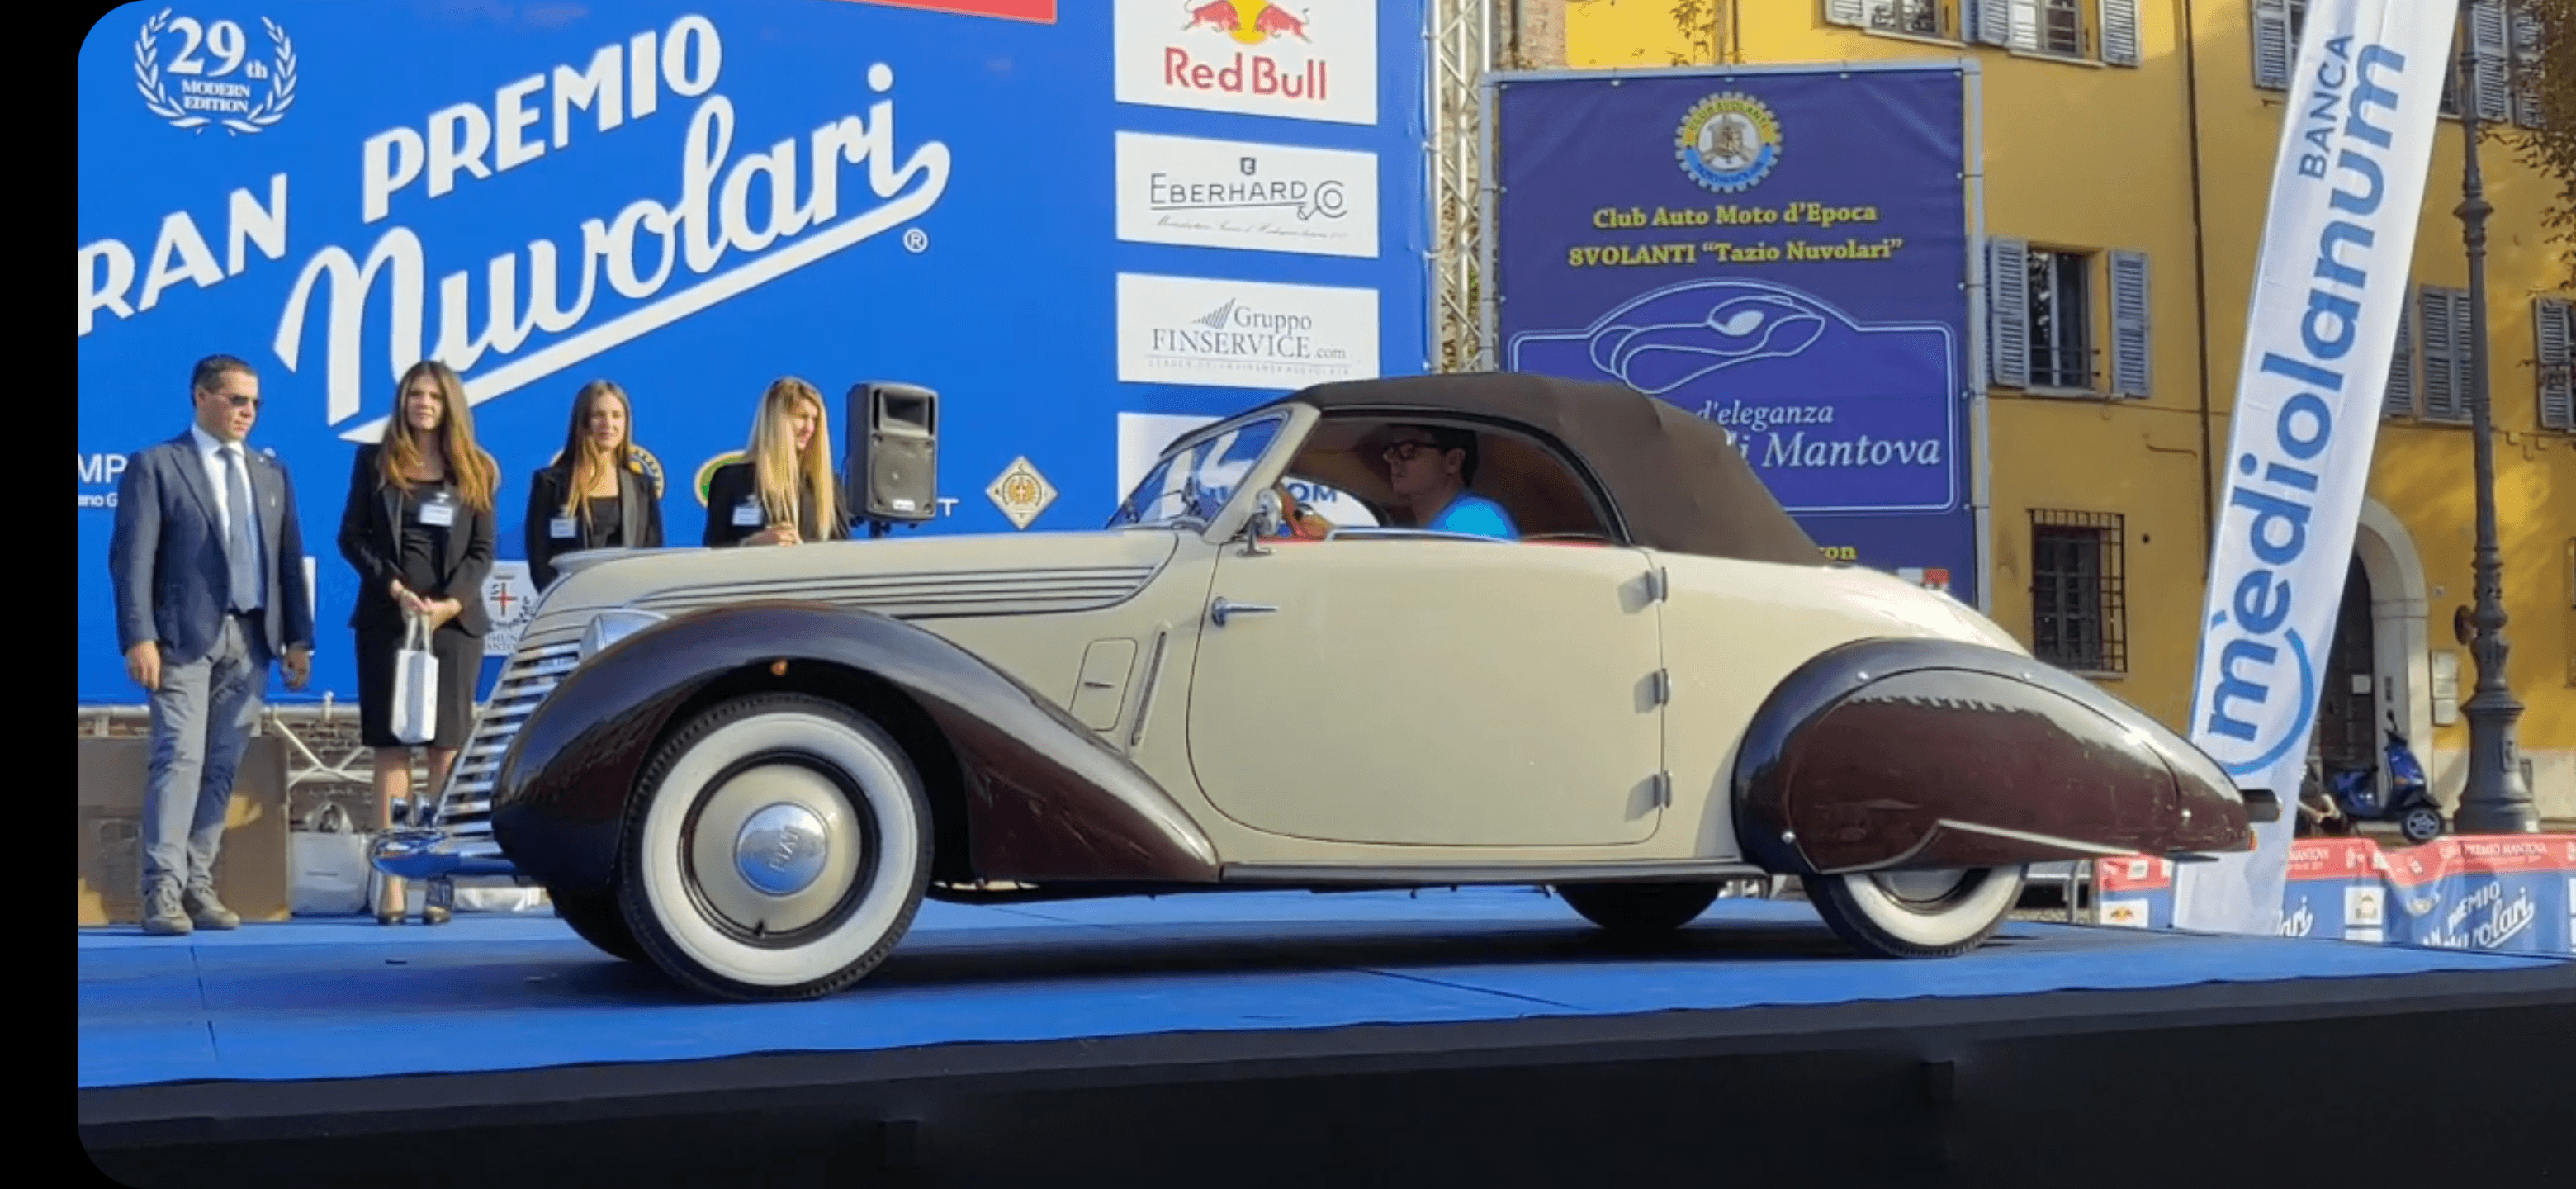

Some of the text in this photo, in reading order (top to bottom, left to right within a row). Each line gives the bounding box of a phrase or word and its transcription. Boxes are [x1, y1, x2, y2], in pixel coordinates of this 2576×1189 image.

[1164, 46, 1327, 100] Red Bull
[181, 79, 250, 98] MODERN
[183, 96, 249, 114] EDITION
[363, 15, 722, 225] PREMIO
[2298, 34, 2354, 181] BANCA
[1150, 173, 1309, 205] EBERHARD
[1593, 208, 1647, 229] Club
[1651, 206, 1710, 226] Auto
[1715, 205, 1778, 225] Moto
[1569, 244, 1697, 266] 8VOLANTI
[1234, 306, 1313, 335] Gruppo
[1761, 431, 1942, 467] Mantova
